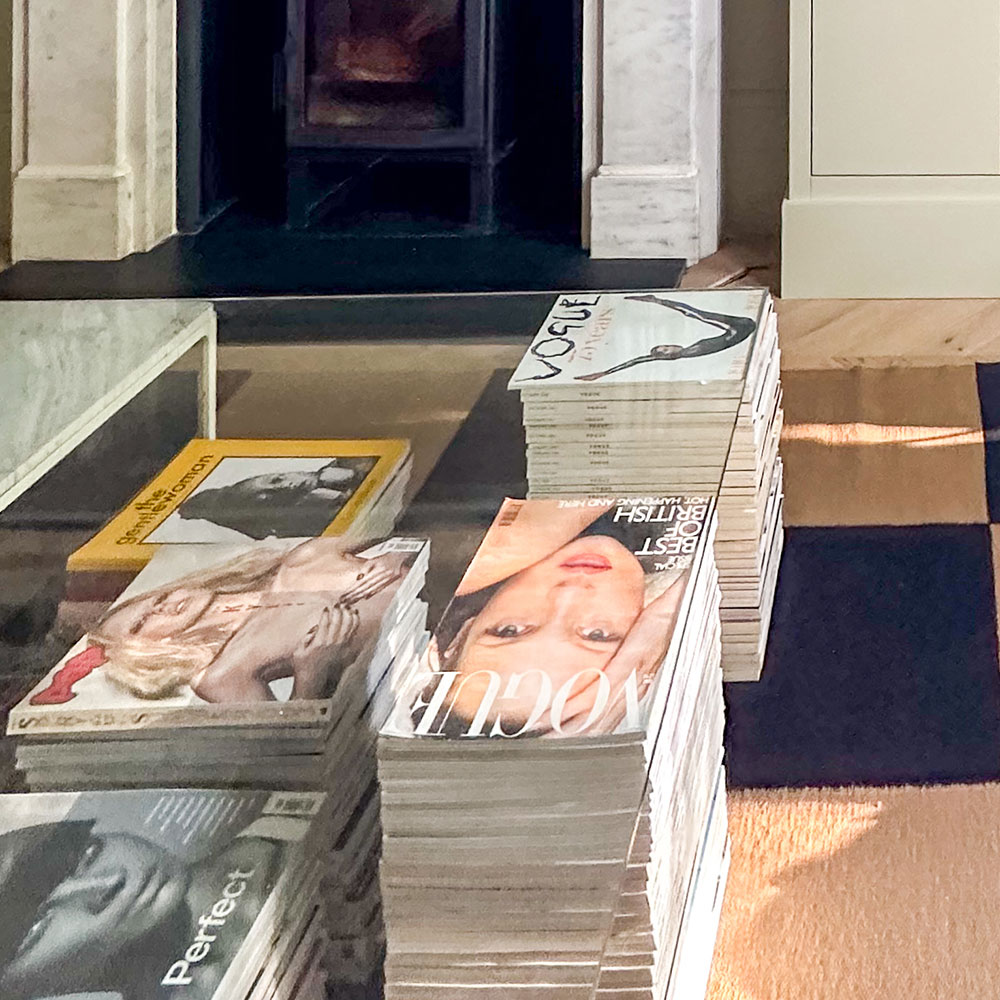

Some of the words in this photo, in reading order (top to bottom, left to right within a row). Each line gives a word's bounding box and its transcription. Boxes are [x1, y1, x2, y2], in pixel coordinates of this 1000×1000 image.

[514, 294, 601, 382] VOGUE
[116, 453, 214, 545] gentlewoman
[135, 486, 169, 512] the
[587, 498, 615, 508] AND
[616, 496, 681, 506] HAPPENING
[613, 504, 708, 523] BRITISH
[664, 520, 702, 538] OF
[634, 536, 699, 556] BEST
[379, 668, 648, 738] VOGUE
[160, 868, 255, 987] Perfect
